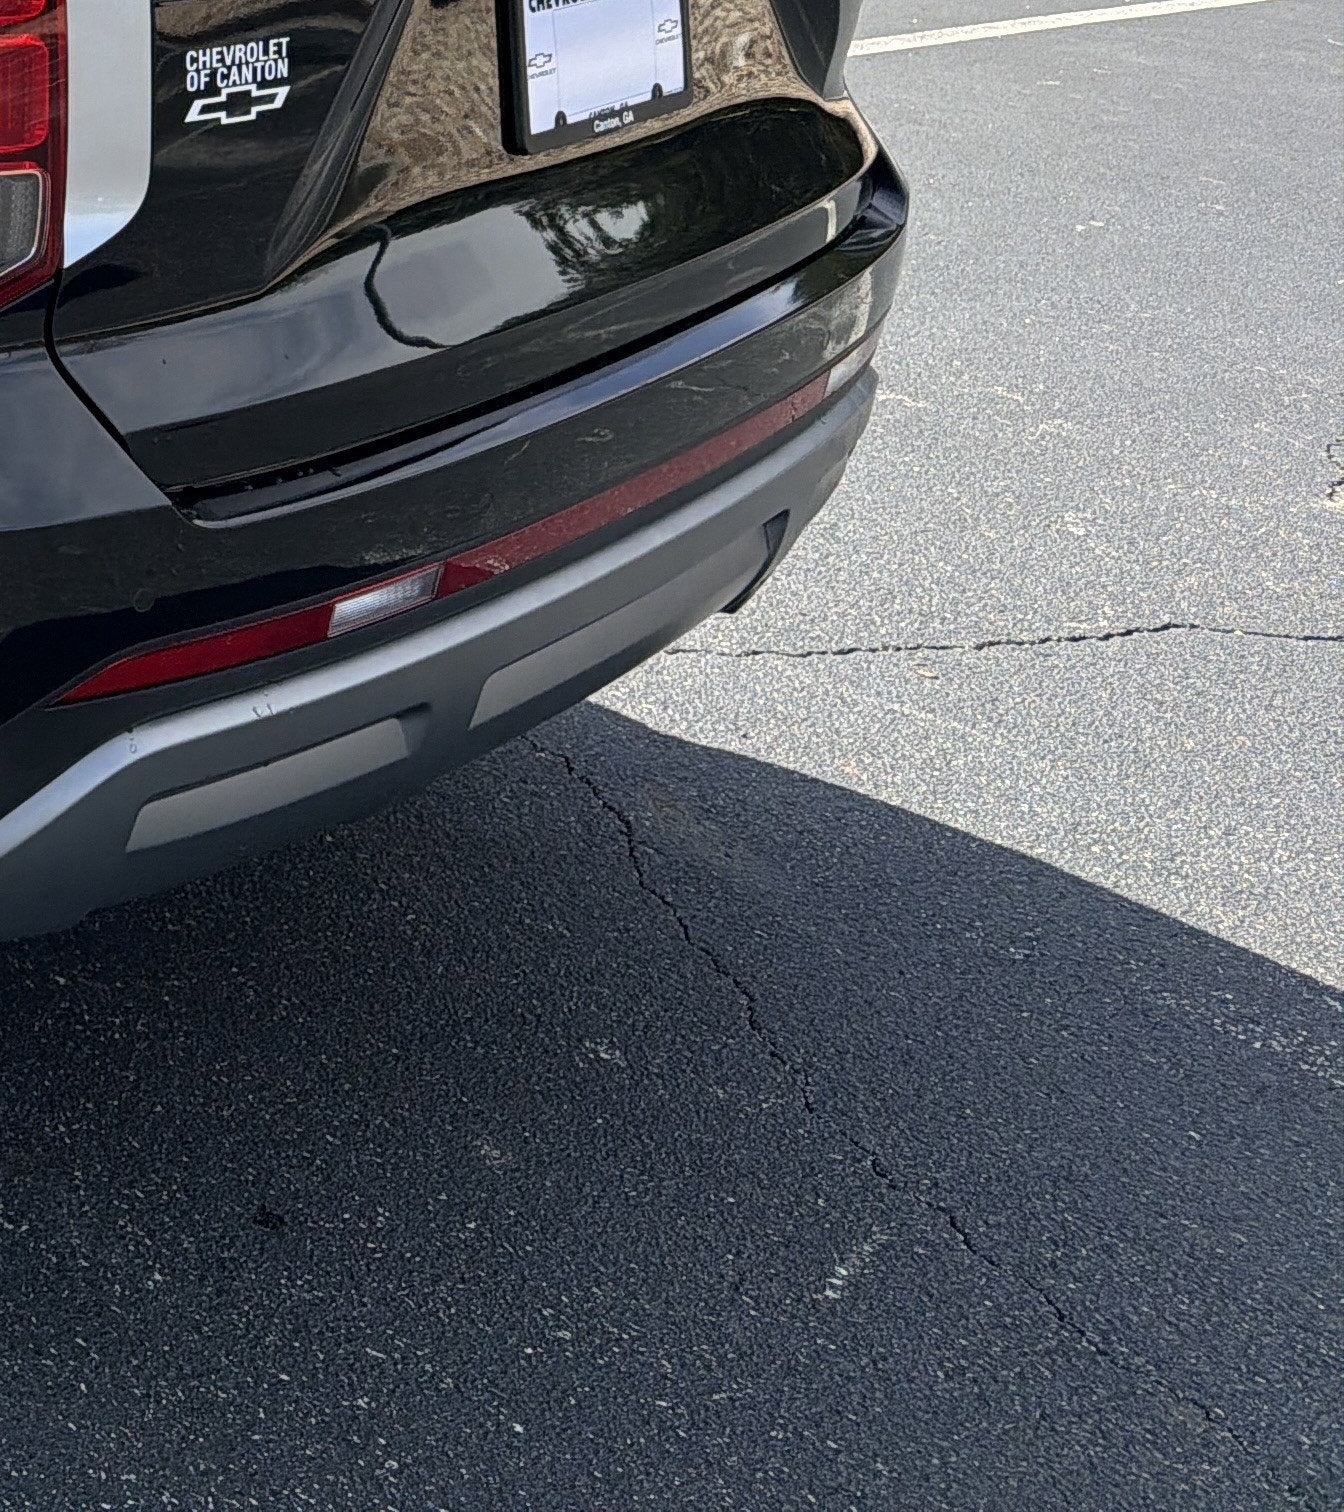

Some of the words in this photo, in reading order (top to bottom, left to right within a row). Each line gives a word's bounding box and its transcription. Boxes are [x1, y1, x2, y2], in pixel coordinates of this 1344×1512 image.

[185, 36, 291, 71] CHEVROLET
[186, 69, 212, 92] OF
[216, 57, 289, 88] CANTON
[622, 110, 635, 124] GA
